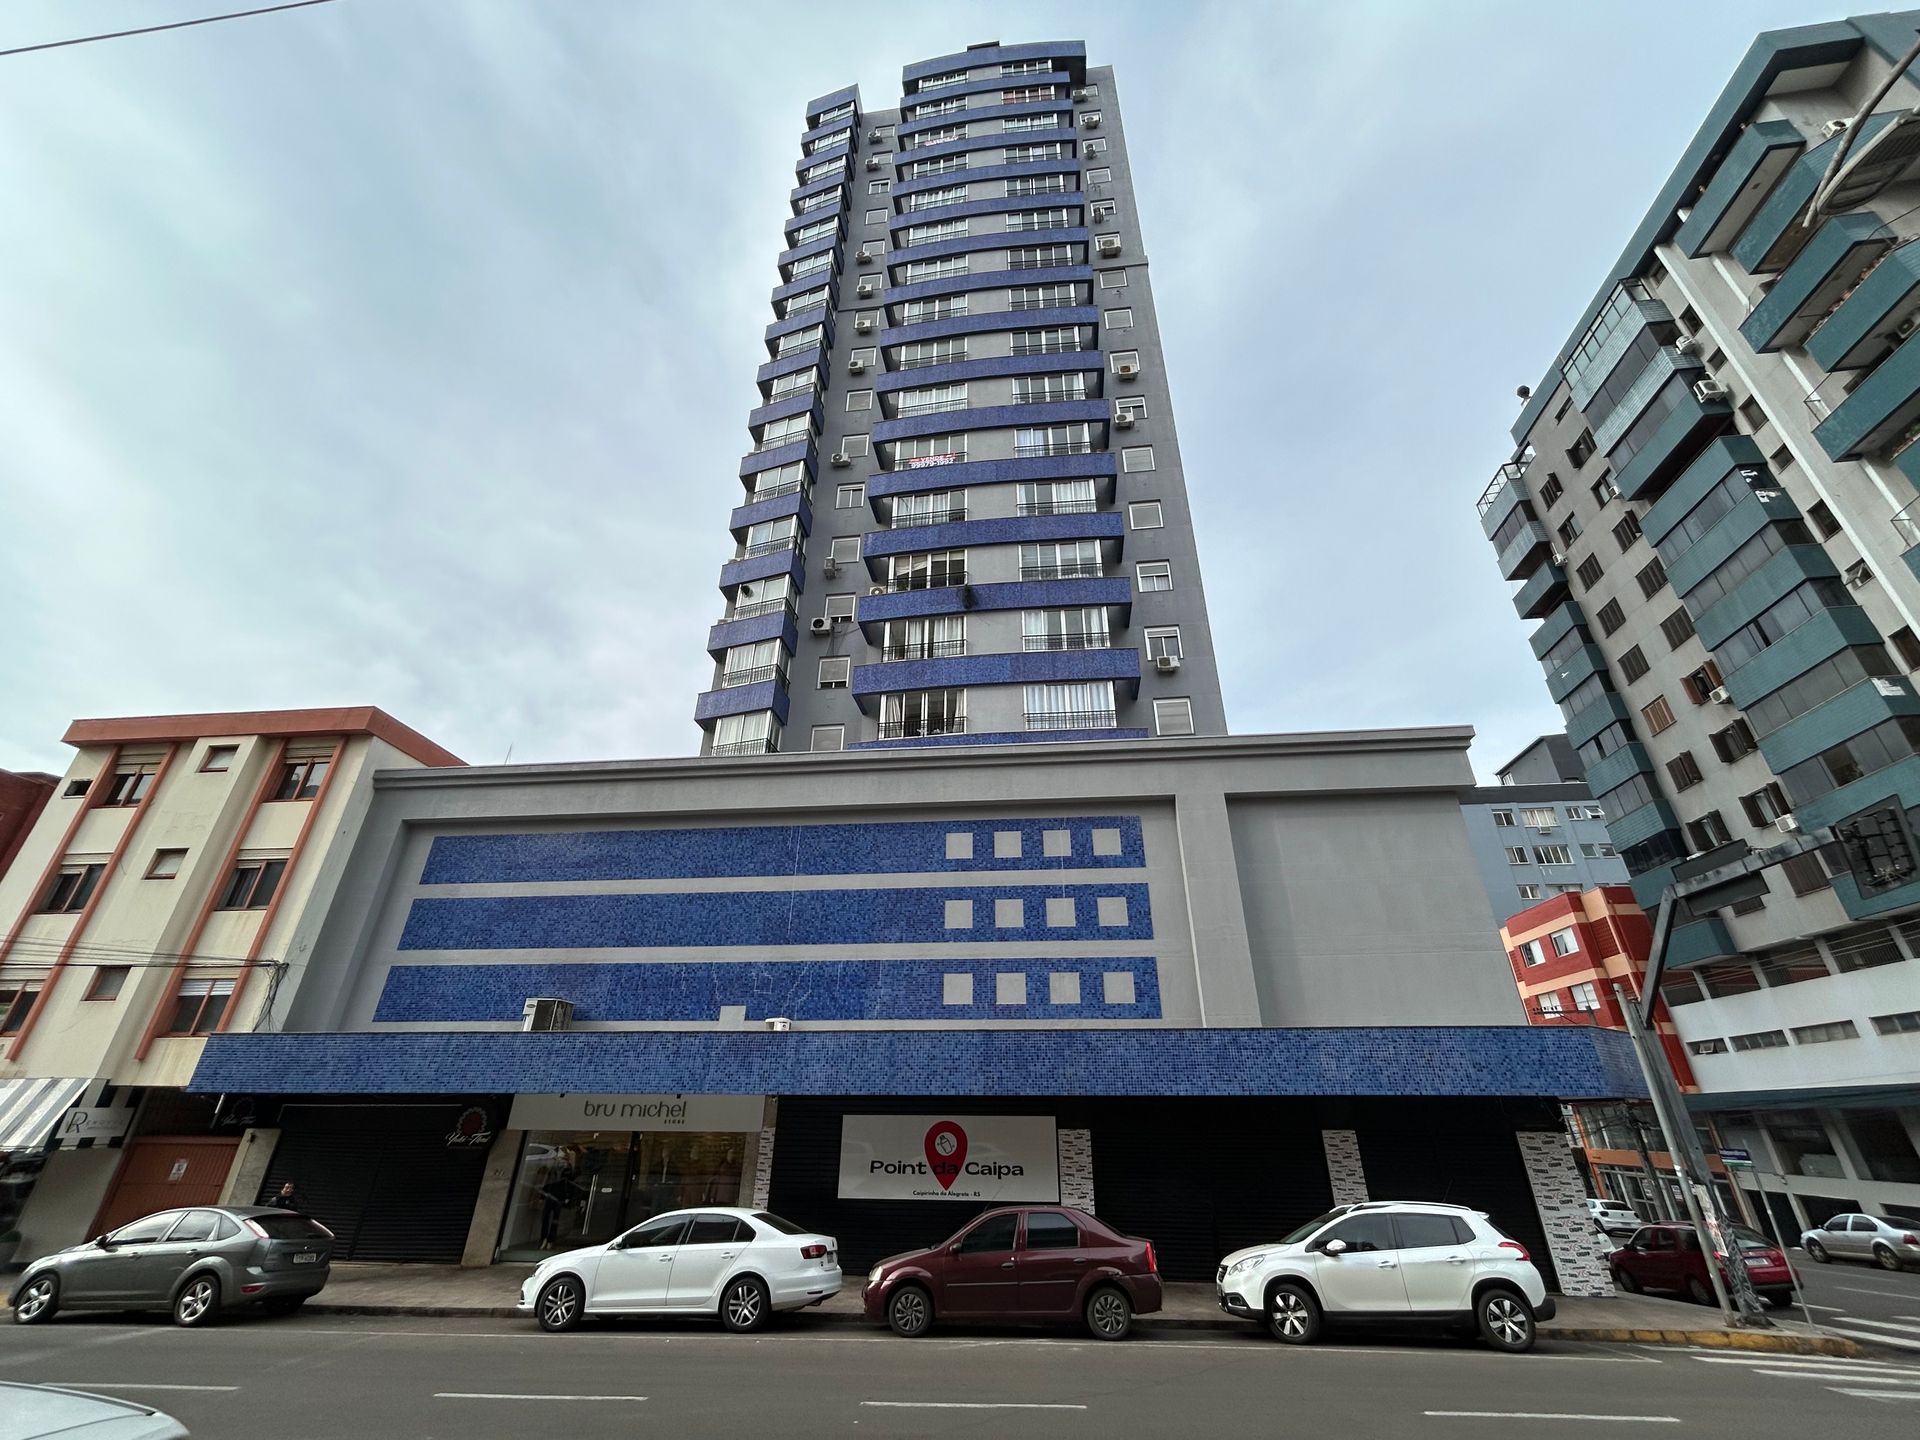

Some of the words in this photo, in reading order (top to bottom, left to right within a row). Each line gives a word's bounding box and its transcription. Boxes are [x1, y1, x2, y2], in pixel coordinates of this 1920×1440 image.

[584, 1100, 616, 1117] bru
[620, 1101, 687, 1118] michel
[870, 1160, 927, 1175] Point
[933, 1161, 959, 1175] da
[965, 1162, 1024, 1180] Caipa
